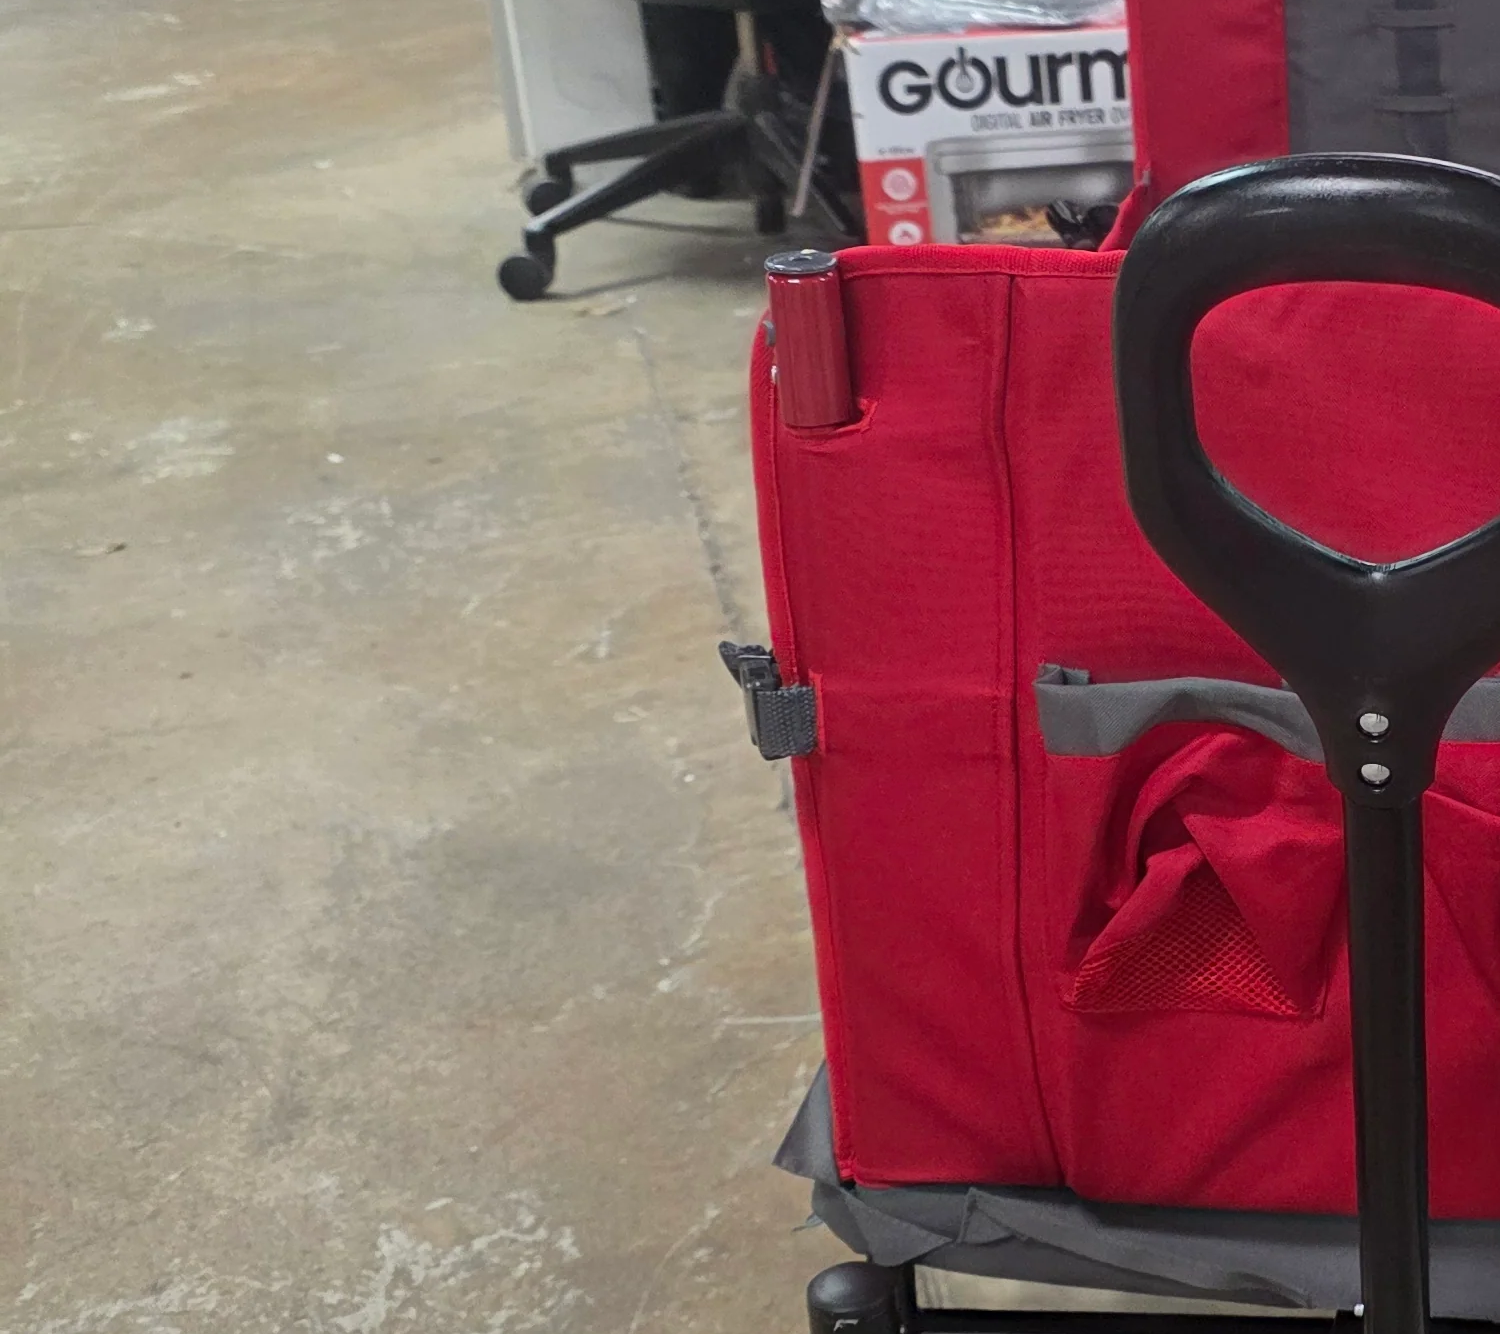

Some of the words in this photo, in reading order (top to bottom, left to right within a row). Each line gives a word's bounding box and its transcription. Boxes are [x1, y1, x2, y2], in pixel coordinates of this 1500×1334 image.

[970, 112, 1023, 132] DIGITAL
[1028, 109, 1053, 128] AIR
[1057, 106, 1106, 127] FRYER
